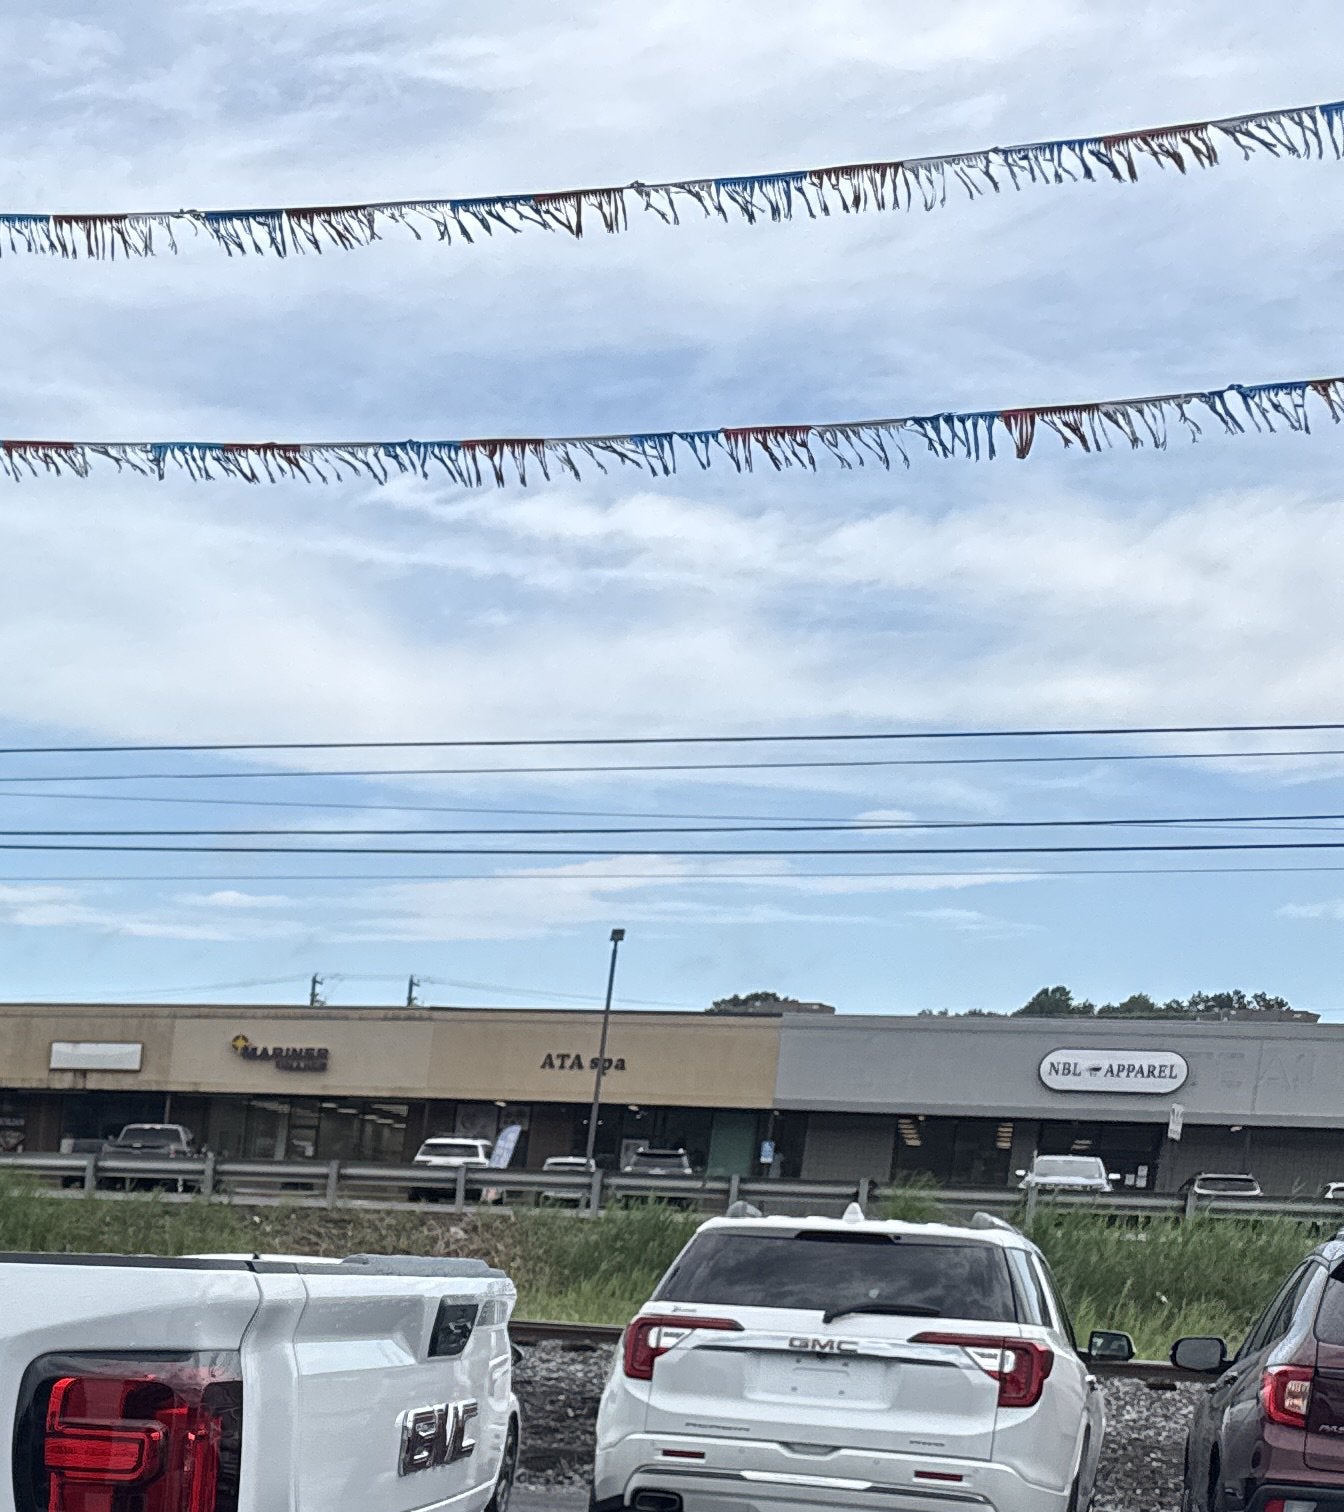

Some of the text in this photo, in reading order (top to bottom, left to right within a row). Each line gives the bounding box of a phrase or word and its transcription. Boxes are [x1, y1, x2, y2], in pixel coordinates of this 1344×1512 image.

[540, 1053, 626, 1076] ATA spa
[1048, 1061, 1178, 1079] NBL APPAREL
[788, 1336, 860, 1353] GMC
